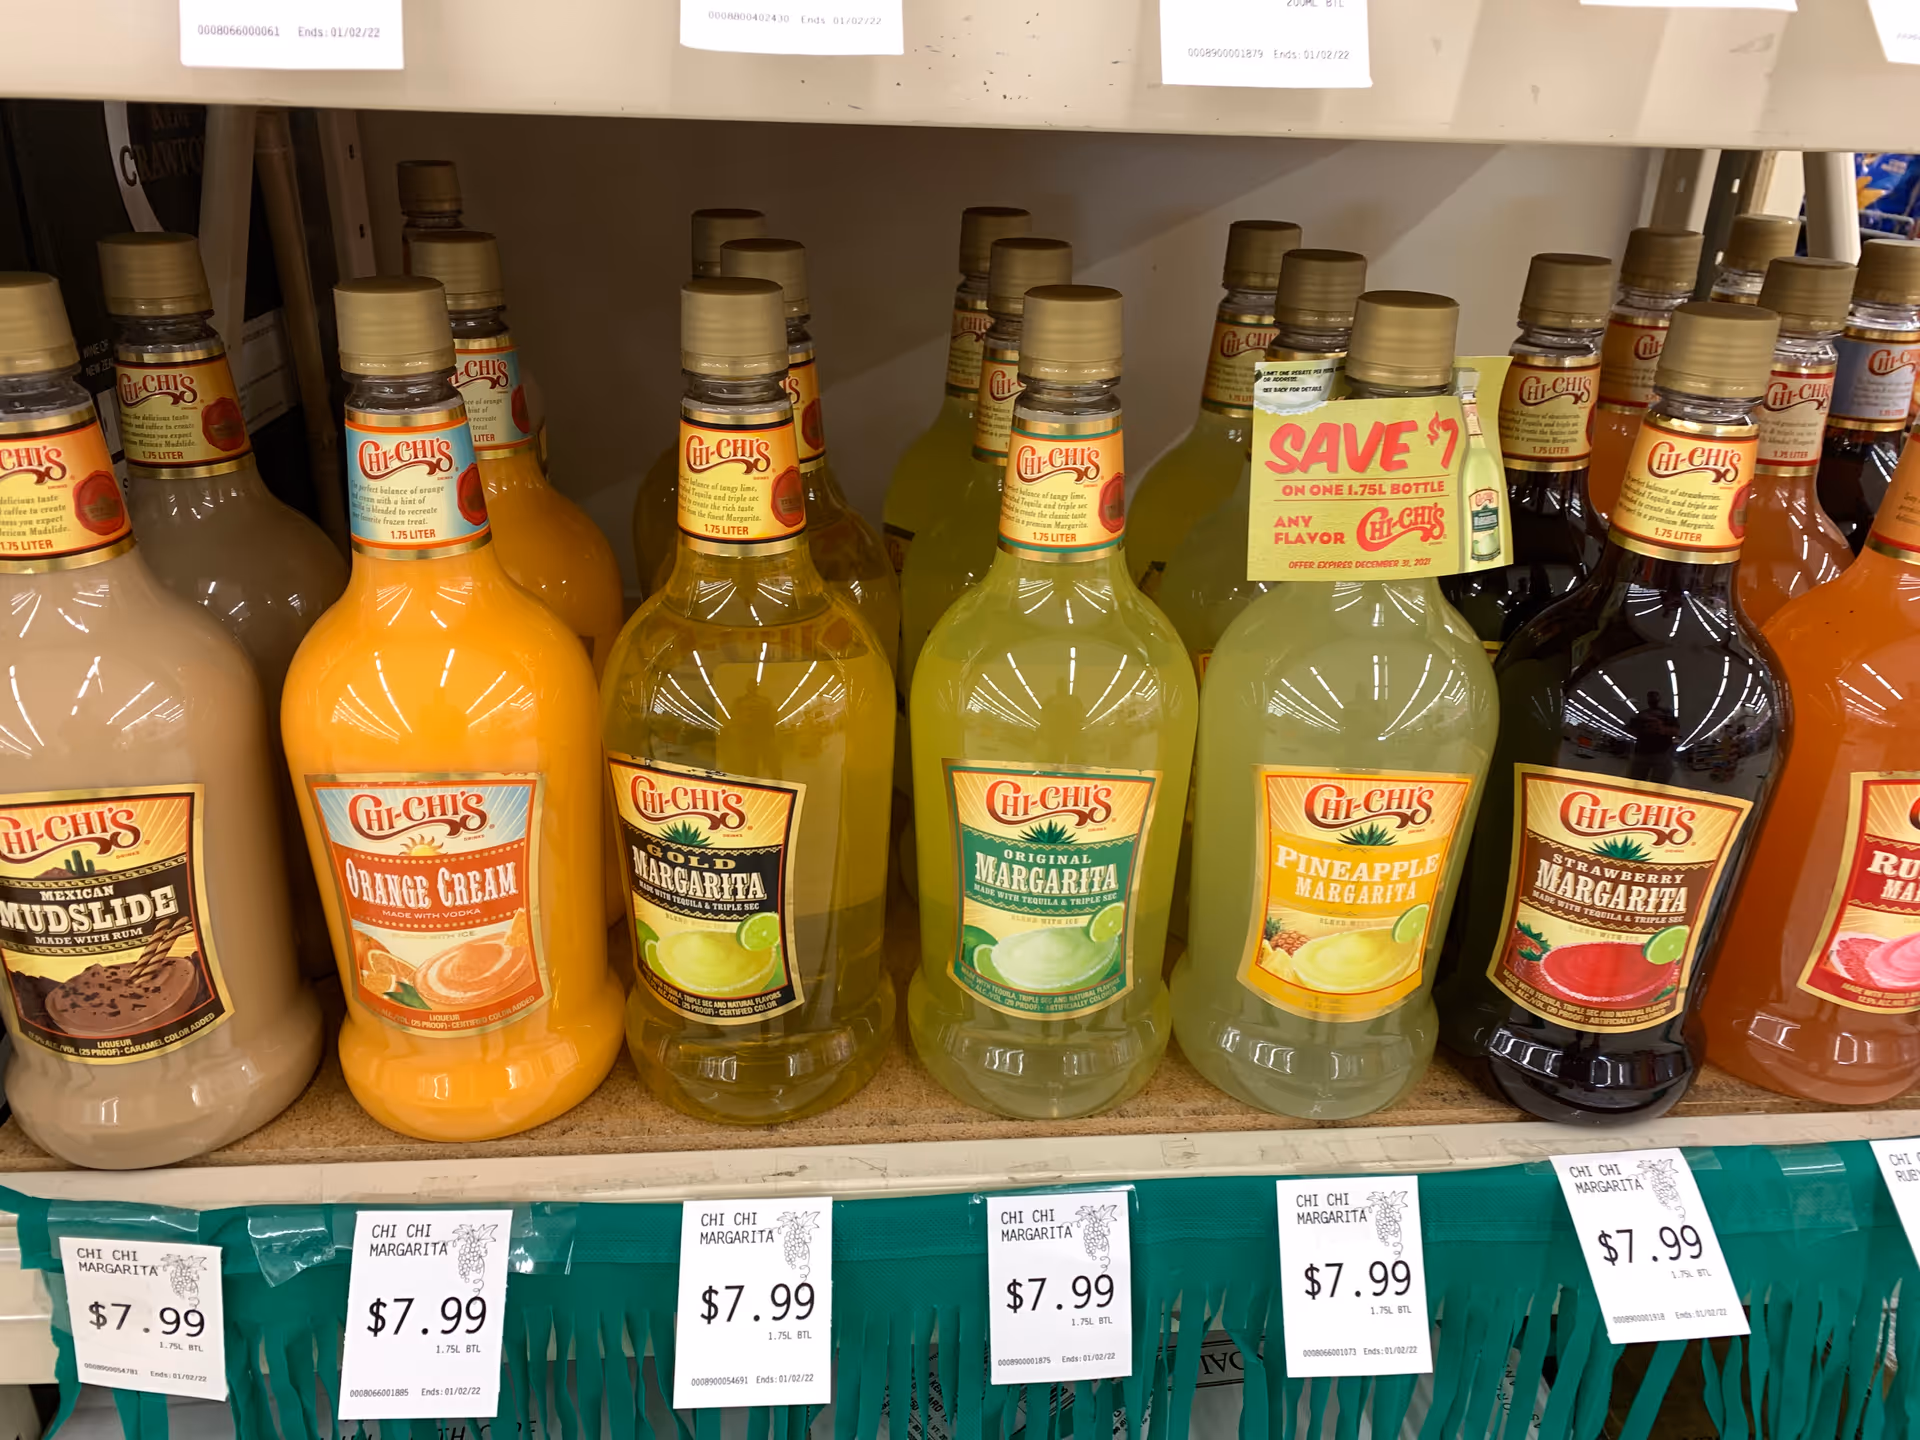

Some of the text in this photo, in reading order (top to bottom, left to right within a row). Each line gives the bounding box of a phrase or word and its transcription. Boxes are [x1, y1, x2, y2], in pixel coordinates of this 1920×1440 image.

[119, 373, 198, 406] CHI-CHI'S
[1519, 376, 1592, 406] CHI-CHI'S
[1265, 419, 1418, 473] SAVE
[1427, 411, 1459, 468] $7
[158, 451, 184, 459] LITER
[358, 438, 454, 480] CHI-CHI'S
[686, 434, 771, 475] CHI-CHI'S
[1647, 441, 1742, 484] CHI-CHI'S
[1016, 445, 1100, 484] CHI-CHI'S
[1281, 480, 1445, 496] ON ONE 1.75L BOTTLE
[704, 523, 749, 535] 1.75 LITER
[1274, 515, 1313, 528] ANY
[1357, 502, 1446, 552] CHI-CHI'S
[391, 529, 436, 540] 1.75 LITER
[1033, 532, 1076, 542] 1.75 LITER
[1274, 532, 1346, 544] FLAVOR
[1655, 527, 1702, 541] 1.75 LITER
[21, 539, 53, 550] LITER
[1289, 560, 1315, 569] OFFER
[1317, 560, 1353, 569] EXPIRES
[1355, 559, 1400, 568] DECEMBER
[1414, 558, 1431, 566] 2021
[631, 775, 746, 831] CHI-CHI'S
[986, 780, 1112, 827] CHI-CHI'S
[1304, 784, 1434, 830] CHI-CHI'S
[349, 790, 487, 841] CHI-CHI'S
[1560, 791, 1696, 847] CHI-CHI'S
[647, 844, 737, 869] GOLD
[1004, 849, 1091, 864] ORIGINAL
[1275, 844, 1440, 882] PINEAPPLE
[632, 845, 767, 901] MARGARITA
[1552, 853, 1685, 884] STRAWBERRY
[1867, 850, 1920, 880] RU
[975, 851, 1119, 896] MARGARITA
[345, 858, 518, 909] ORANGE CREAM
[1295, 876, 1416, 905] MARGARITA
[1534, 858, 1688, 916] MARGARITA
[40, 885, 114, 901] MEXICAN
[656, 888, 671, 902] WITH
[672, 894, 703, 908] TEQUILA
[704, 902, 711, 910] &
[712, 902, 742, 911] TRIPLE
[744, 903, 760, 911] SEC
[973, 884, 1117, 906] MADE WITH TEQUILA & TRIPLE SEC
[0, 885, 179, 934] MUDSLIDE
[382, 908, 481, 919] MADE WITH VODKA
[1532, 890, 1684, 924] MADE WITH TEQUILA & TRIPLE SEC
[35, 927, 143, 945] MADE WITH RUM
[756, 991, 782, 1004] FLAVORS
[1502, 969, 1518, 986] MADE
[1519, 982, 1534, 996] WITH
[1586, 1009, 1599, 1017] SEC
[513, 995, 535, 1011] ADDED
[719, 1000, 777, 1016] CERTIFIED COLOR
[124, 1038, 164, 1054] CARAMEL
[165, 1028, 190, 1043] COLOR
[190, 1012, 216, 1031] ADDED
[97, 1039, 132, 1048] LIQUEUR
[1889, 1153, 1912, 1166] CHI
[1569, 1163, 1622, 1178] CHI CHI
[1575, 1178, 1644, 1194] MARGARITA
[1296, 1193, 1349, 1208] CHI CHI
[701, 1212, 757, 1227] CHI CHI
[1001, 1209, 1055, 1225] CHI CHI
[1297, 1209, 1367, 1225] MARGARITA
[372, 1223, 432, 1238] CHI CHI
[700, 1230, 774, 1245] MARGARITA
[1001, 1226, 1072, 1242] MARGARITA
[369, 1243, 448, 1256] MARGARITA
[1598, 1224, 1703, 1266] $7.99
[77, 1248, 138, 1261] CHI CHI
[79, 1262, 159, 1277] MARGARITA
[1671, 1268, 1712, 1279] 1.75L BTL
[1304, 1260, 1411, 1300] $7.99
[1006, 1274, 1114, 1313] $7.99
[700, 1282, 815, 1325] $7.99
[1370, 1305, 1412, 1315] 1.75L BTL
[88, 1301, 205, 1338] $7.99
[366, 1296, 487, 1337] $7.99
[1071, 1316, 1113, 1326] 1.75L BTL
[768, 1330, 812, 1340] 1.75L BTL
[159, 1341, 204, 1352] 1.75L BTL
[436, 1344, 481, 1354] 1.75L BTL
[1303, 1348, 1357, 1357] 0008066001073
[998, 1356, 1051, 1367] 0008900001875
[691, 1376, 748, 1386] 0008900054691
[350, 1388, 409, 1398] 0008066001885
